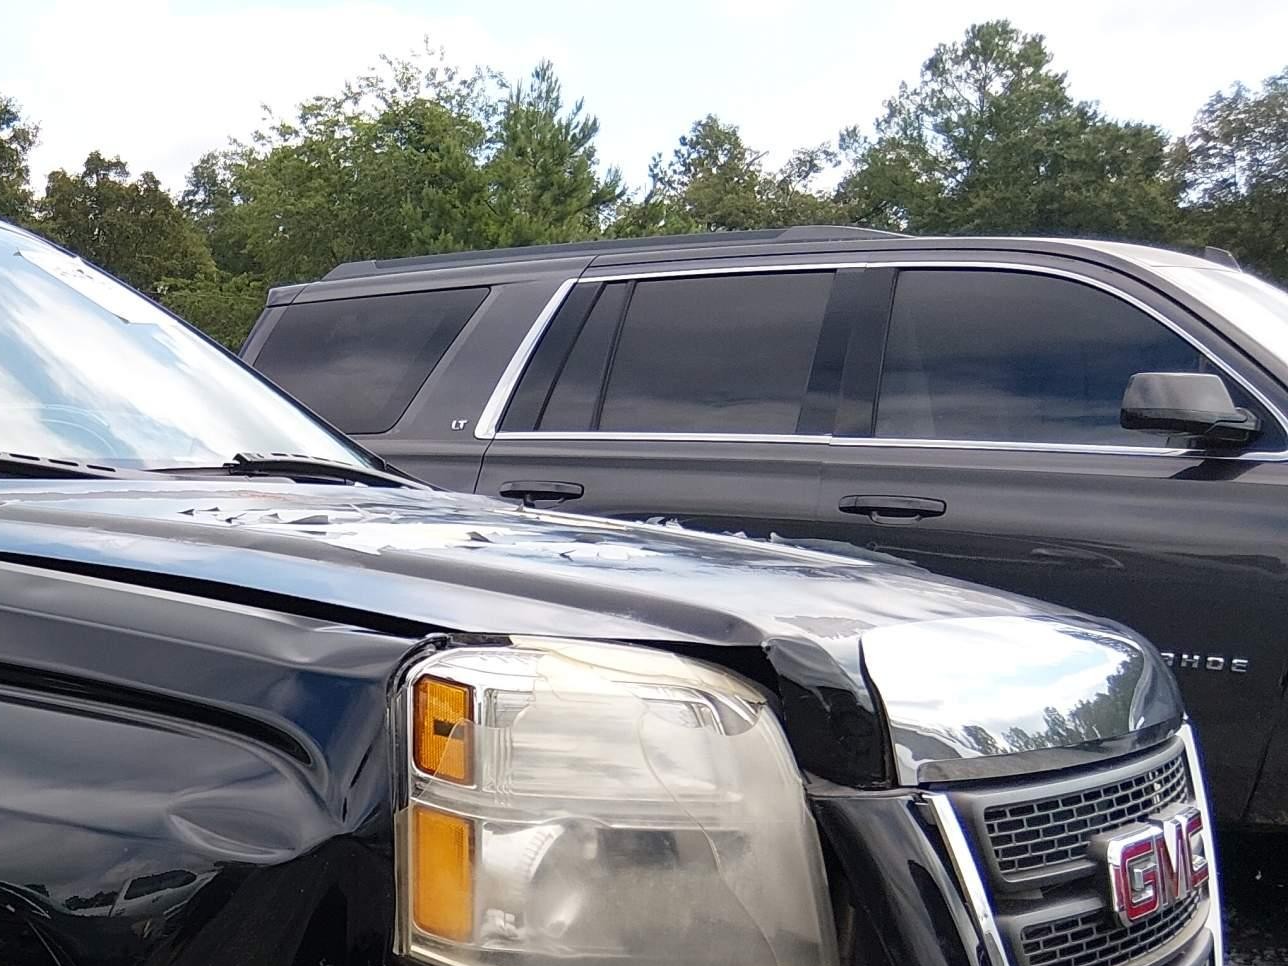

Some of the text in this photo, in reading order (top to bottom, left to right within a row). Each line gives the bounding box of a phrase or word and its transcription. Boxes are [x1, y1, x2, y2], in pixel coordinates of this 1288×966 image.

[451, 419, 468, 430] LT
[1159, 652, 1249, 673] AHOE
[1107, 806, 1209, 924] GMC
